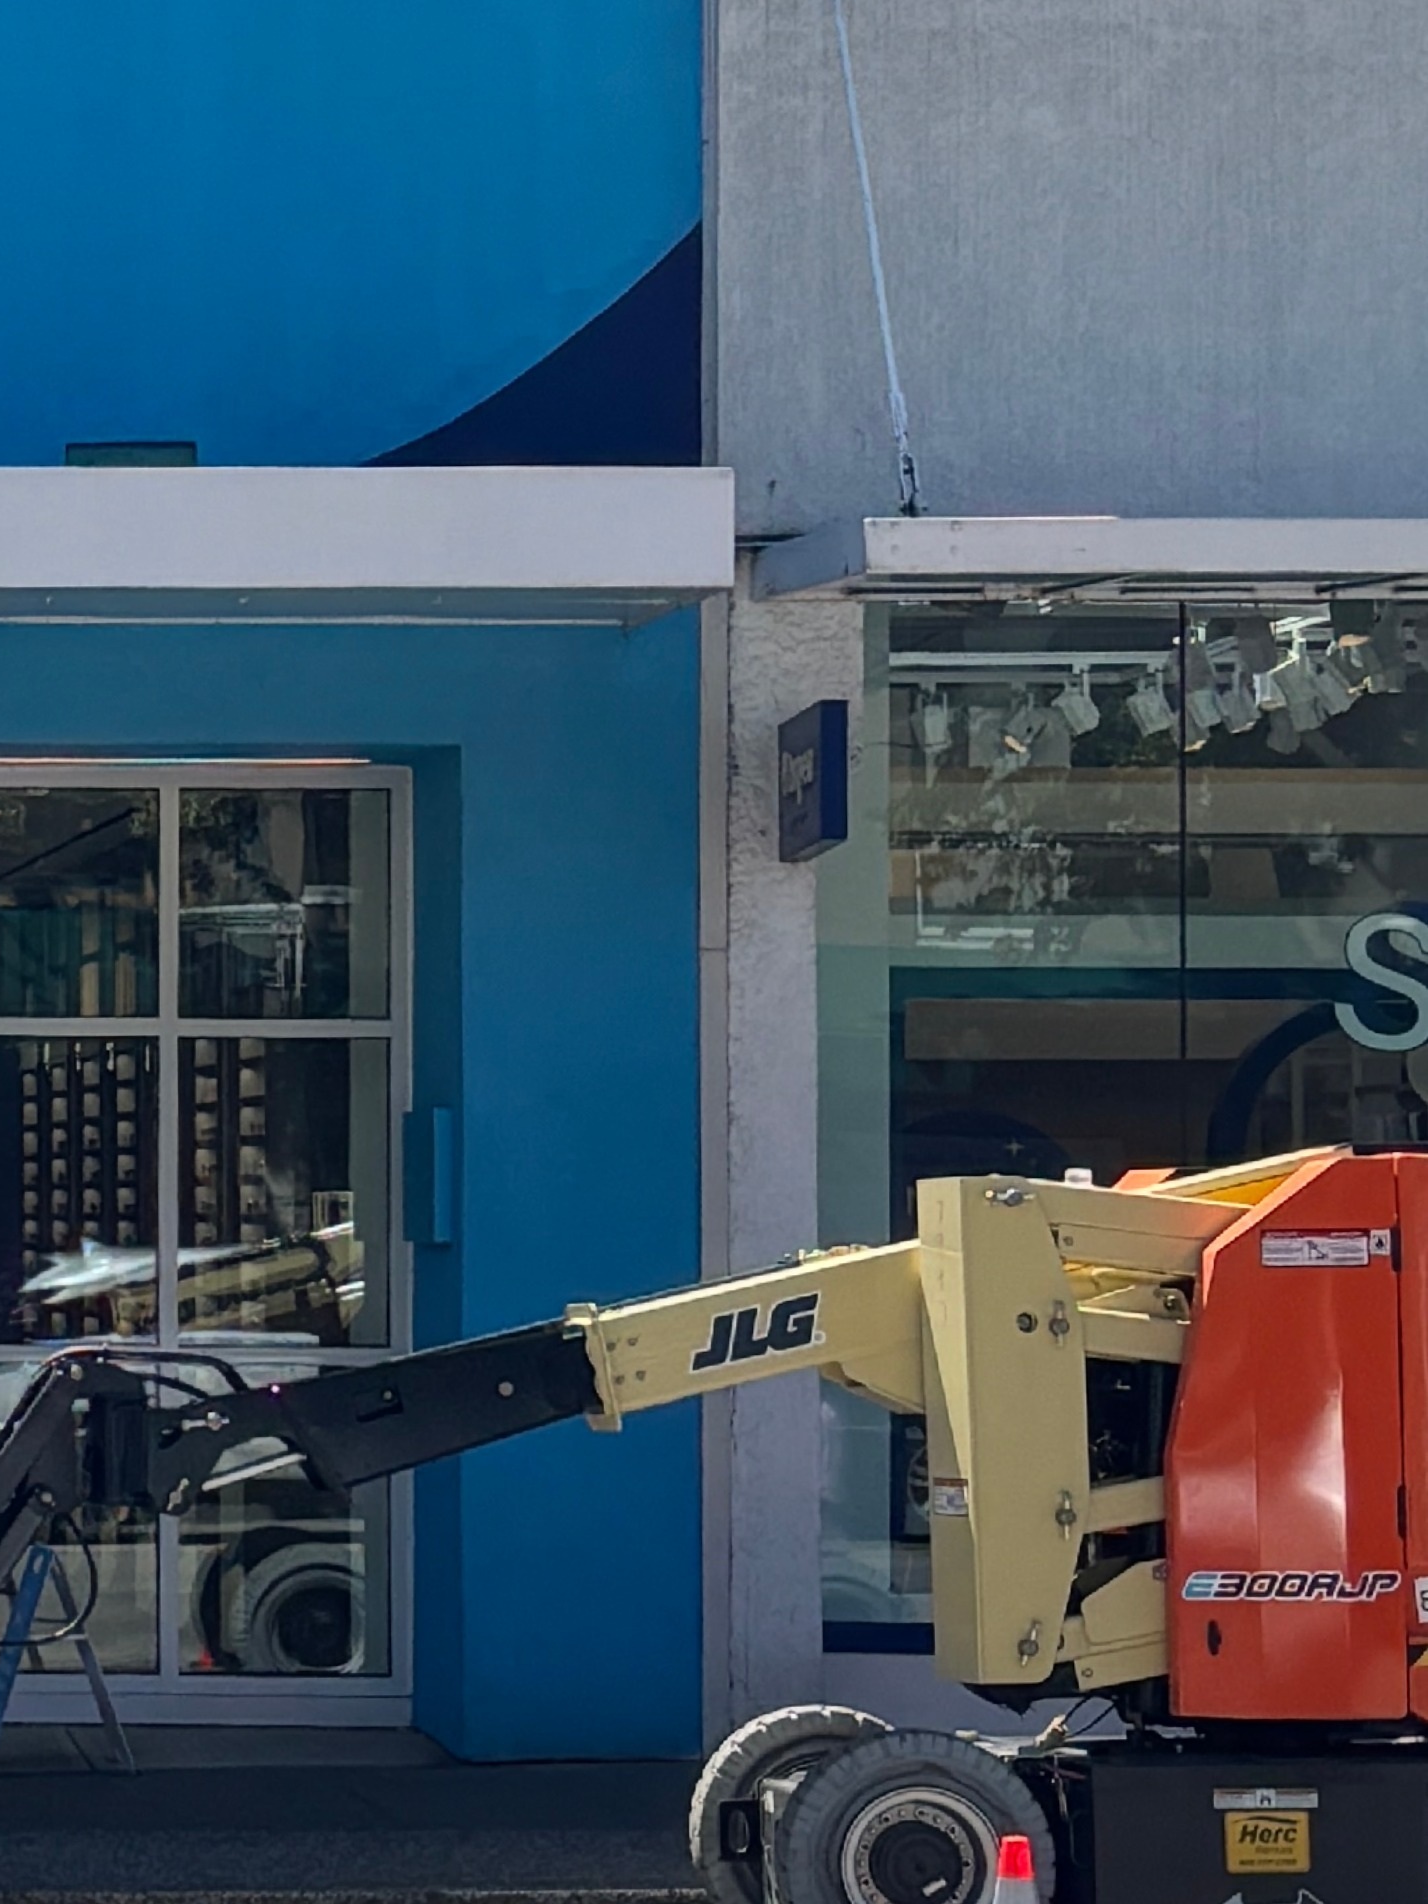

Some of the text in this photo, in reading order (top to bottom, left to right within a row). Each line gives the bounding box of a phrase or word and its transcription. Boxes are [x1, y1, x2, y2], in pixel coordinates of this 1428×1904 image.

[1334, 912, 1428, 1051] S
[691, 1291, 820, 1372] JLG
[1182, 1571, 1401, 1601] E300AJP
[1238, 1823, 1298, 1844] Herc
